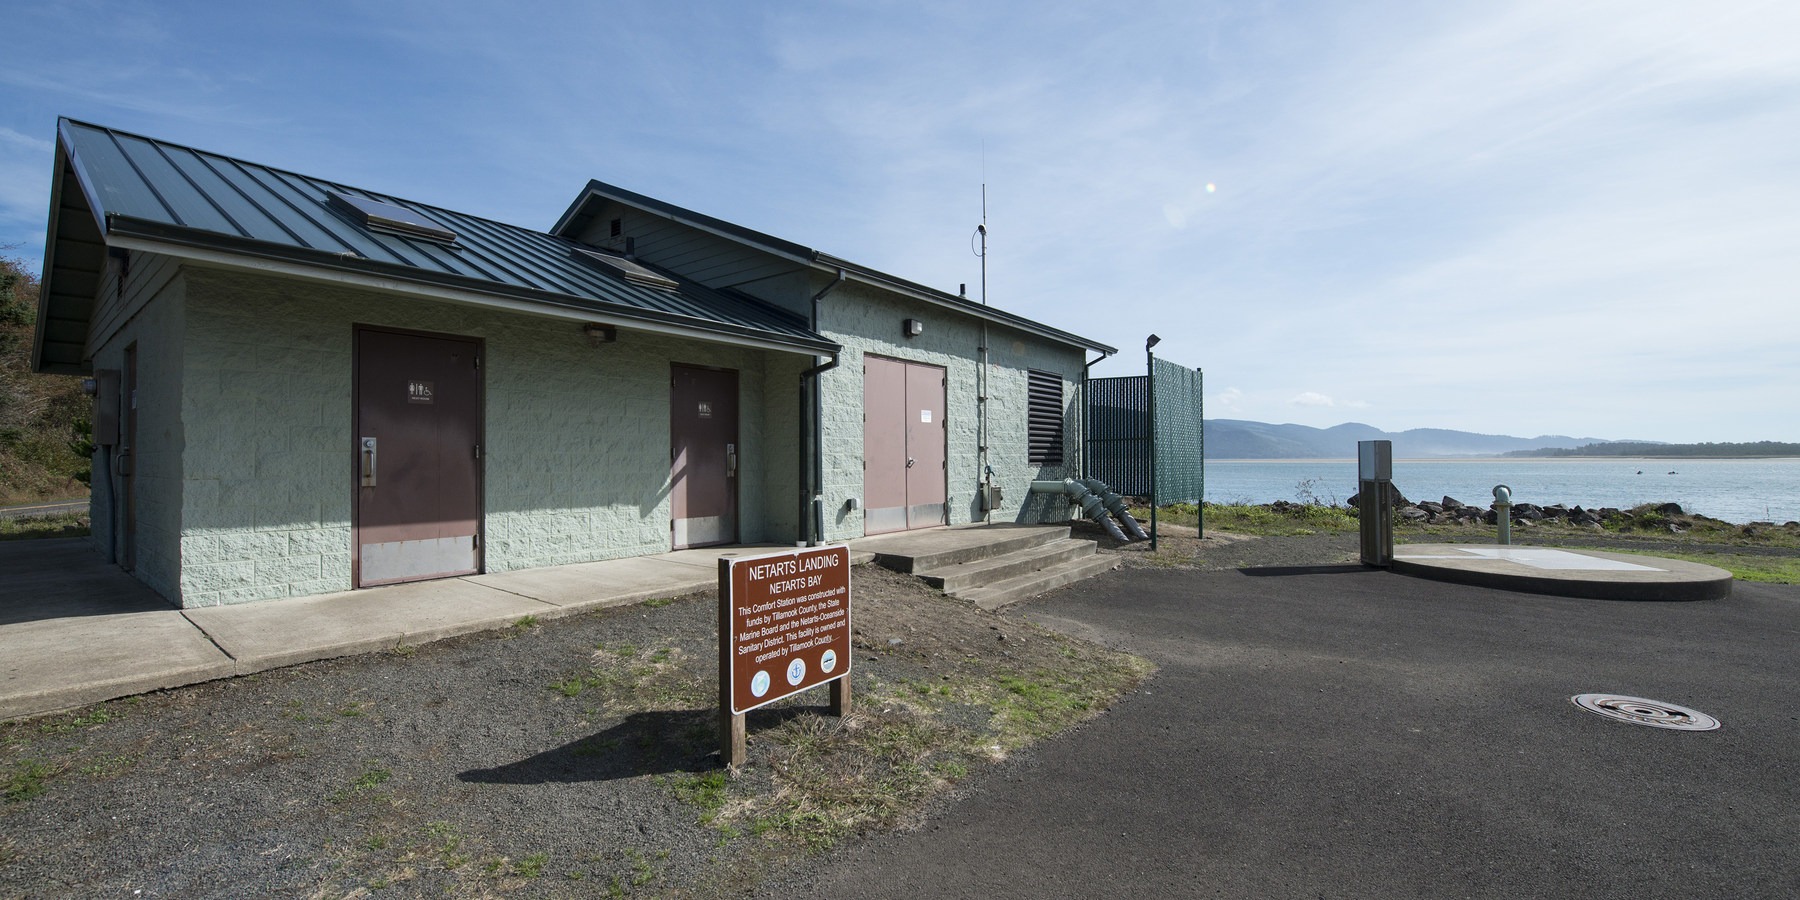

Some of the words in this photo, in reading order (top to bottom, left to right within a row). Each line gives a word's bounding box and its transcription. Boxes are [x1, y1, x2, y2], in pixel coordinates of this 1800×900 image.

[749, 560, 796, 581] NETARTS
[799, 554, 838, 572] LANDING
[769, 578, 805, 595] NETARTS
[808, 575, 822, 586] BAY
[738, 606, 751, 616] This
[752, 600, 776, 613] Comfort
[777, 597, 795, 608] Station
[808, 589, 835, 600] constructed
[836, 586, 845, 594] with
[746, 617, 762, 627] funds
[764, 614, 771, 624] by
[772, 609, 797, 621] Tillamook
[827, 599, 839, 608] State
[738, 642, 763, 655] Sanitary
[764, 638, 784, 648] District.
[786, 632, 797, 641] This
[798, 628, 814, 639] facility
[820, 623, 836, 633] owned
[836, 619, 845, 627] and
[739, 631, 760, 642] Marine
[762, 626, 779, 637] Board
[779, 623, 790, 631] and
[791, 620, 799, 628] the
[800, 610, 844, 626] Netarts-Oceanside
[755, 651, 780, 664] operated
[782, 648, 788, 656] by
[789, 640, 814, 652] Tillamook
